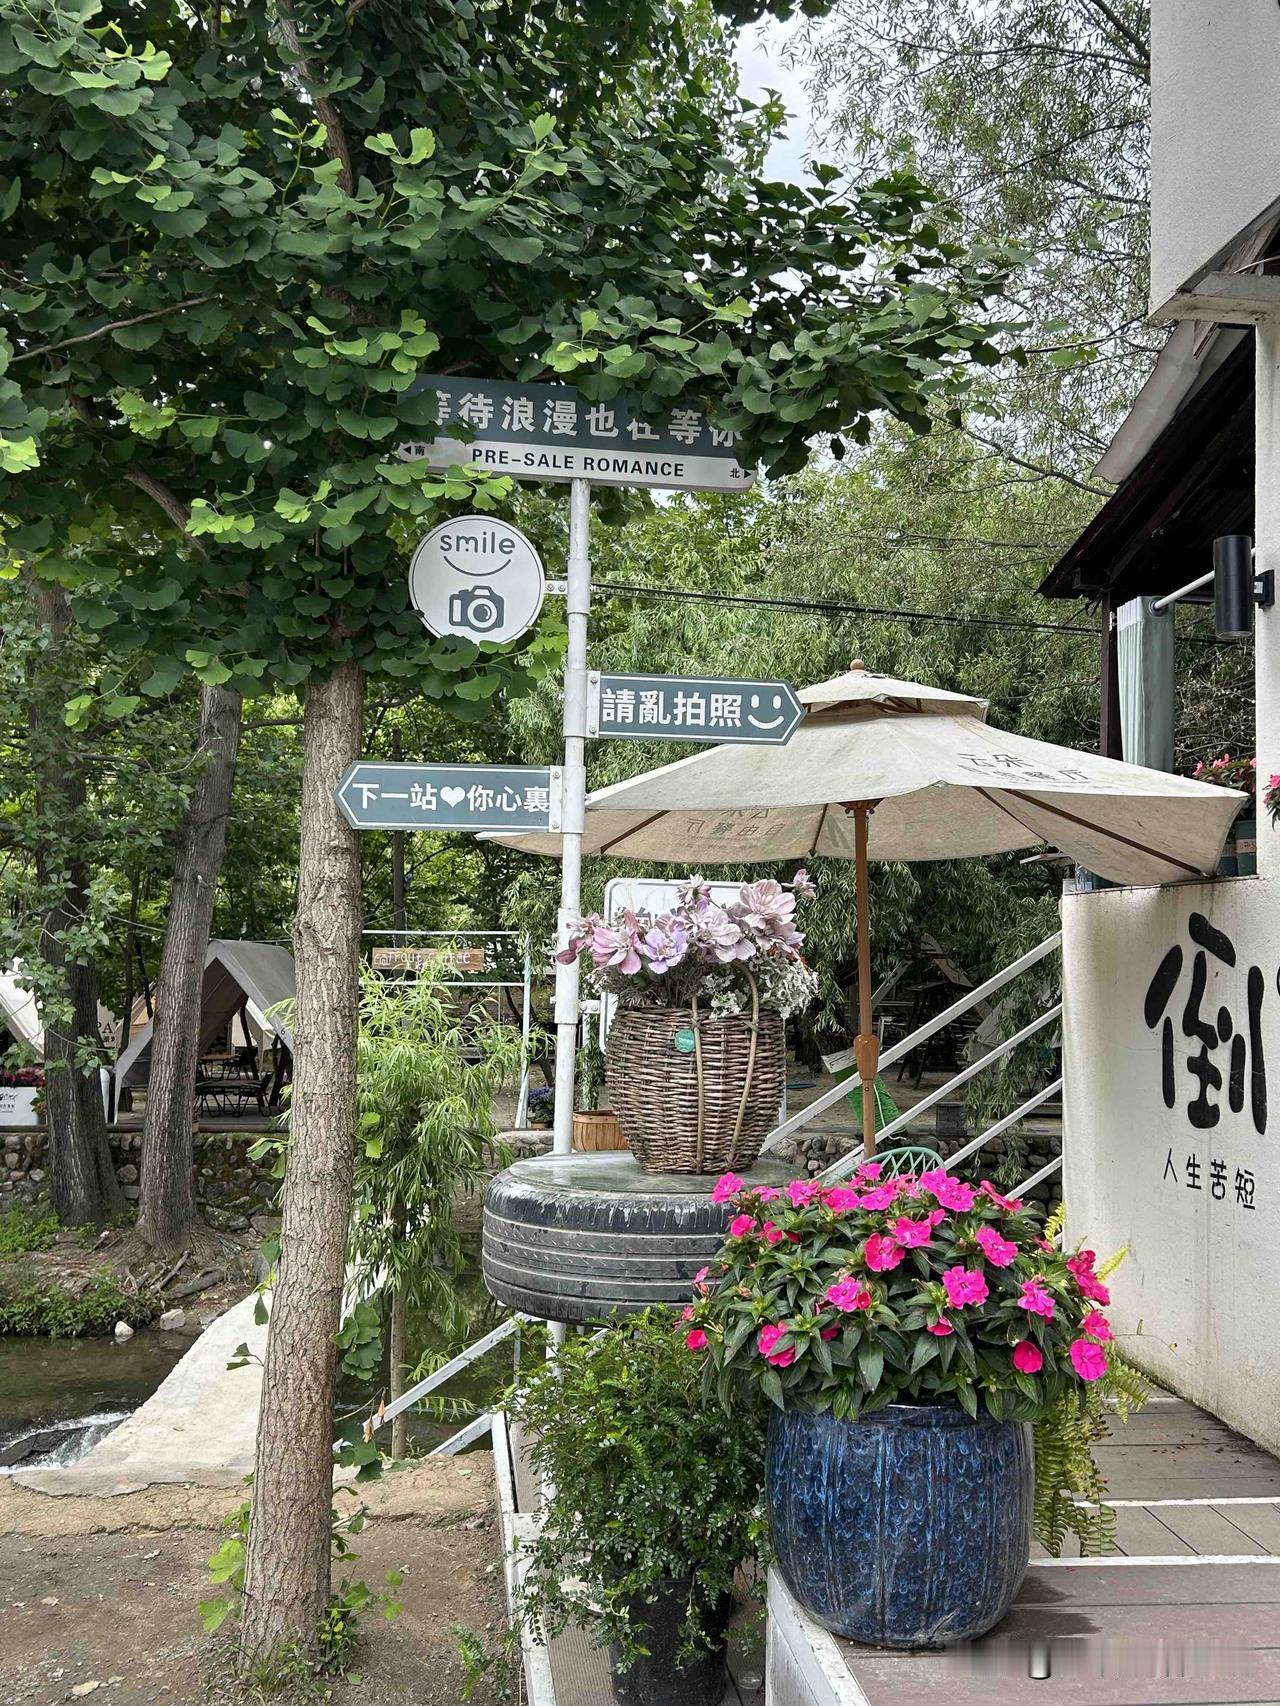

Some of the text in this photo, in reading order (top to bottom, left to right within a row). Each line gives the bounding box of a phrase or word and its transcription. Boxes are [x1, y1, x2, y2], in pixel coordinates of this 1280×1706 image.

[415, 445, 425, 456] 南
[472, 448, 684, 478] PRE-SALE ROMANCE
[730, 467, 740, 479] 北
[440, 531, 515, 555] smile
[602, 688, 742, 728] 請亂拍照
[1163, 1147, 1256, 1211] 人生苦短
